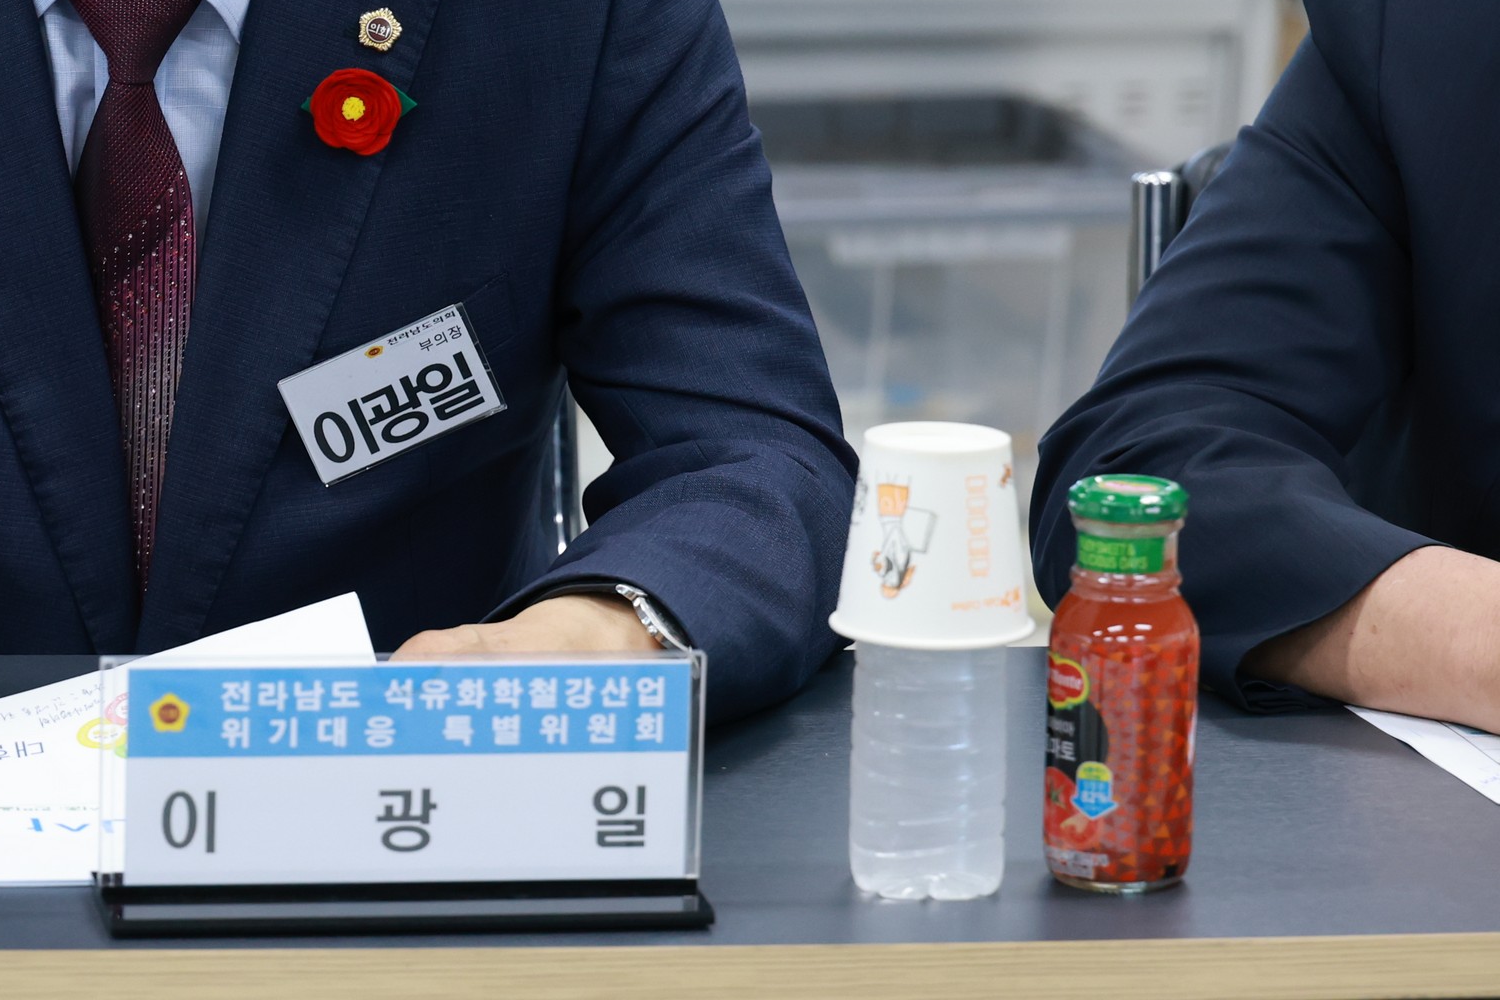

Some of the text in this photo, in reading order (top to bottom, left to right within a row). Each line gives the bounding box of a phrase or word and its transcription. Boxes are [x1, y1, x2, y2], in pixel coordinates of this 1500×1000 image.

[369, 23, 390, 38] 의회
[387, 310, 456, 346] 전라남도의회
[419, 325, 463, 351] 부의장
[314, 351, 485, 463] 이광일
[220, 677, 667, 712] 전라남도 석유화학철강산업
[220, 714, 397, 749] 위기대응
[443, 712, 665, 746] 특별위원회
